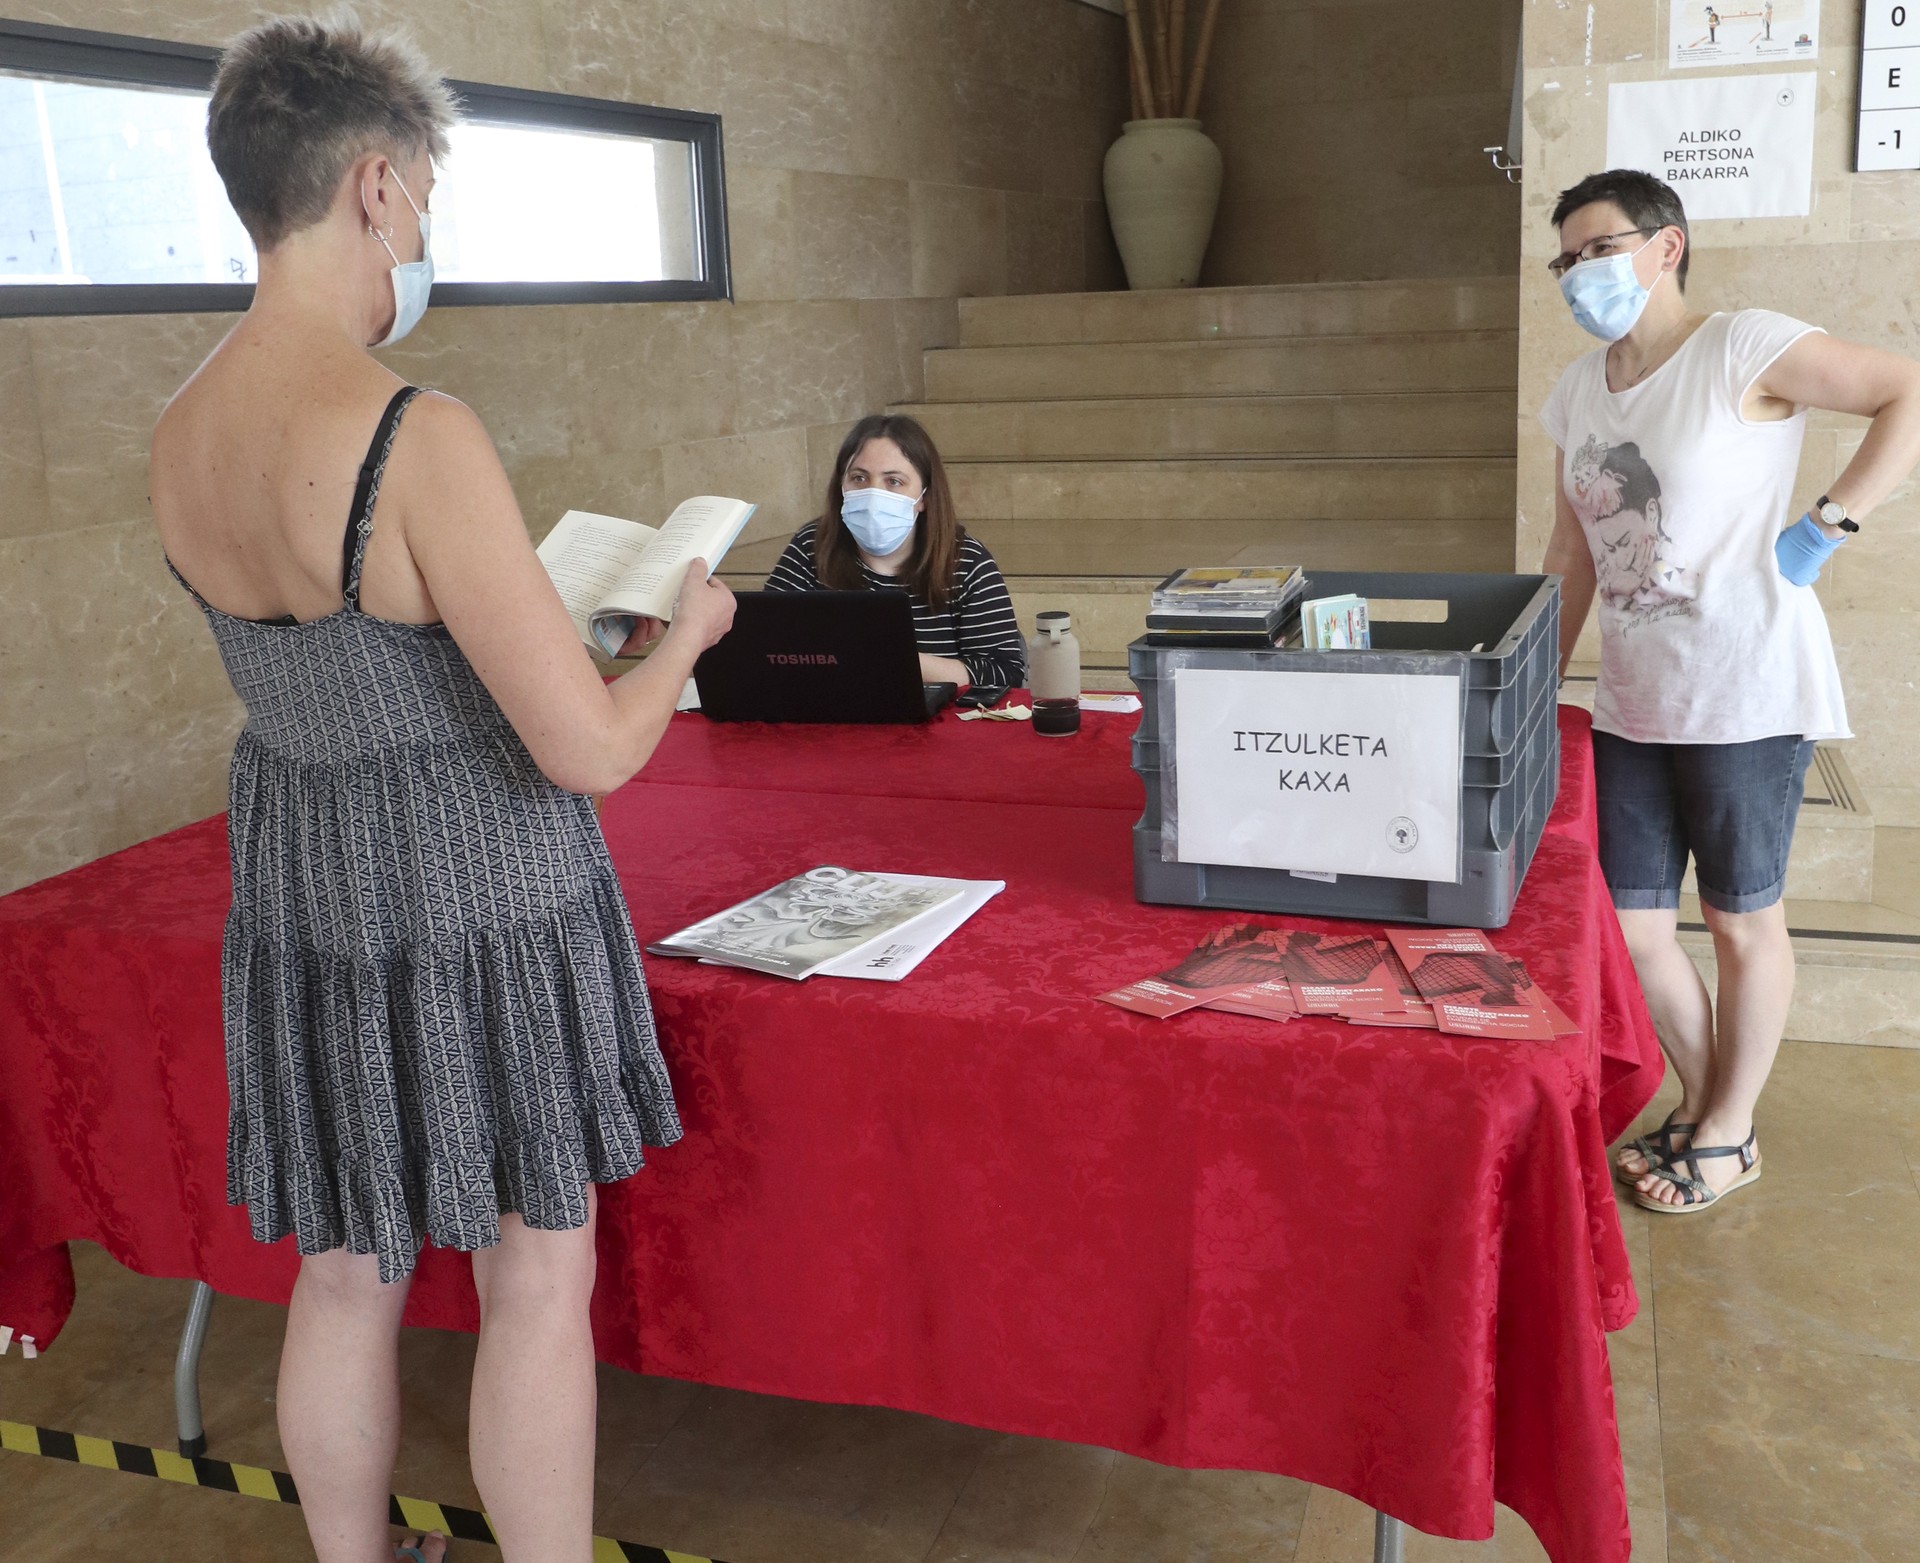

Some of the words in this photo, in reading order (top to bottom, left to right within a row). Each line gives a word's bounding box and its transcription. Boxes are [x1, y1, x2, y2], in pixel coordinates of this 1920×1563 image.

[1888, 68, 1901, 88] E
[1678, 129, 1741, 143] ALDIKO
[1663, 147, 1754, 162] PERTSONA
[1667, 166, 1749, 180] BAKARRA
[766, 654, 838, 665] TOSHIBA
[1233, 731, 1387, 757] ITZULKETA
[1279, 769, 1350, 792] KAXA
